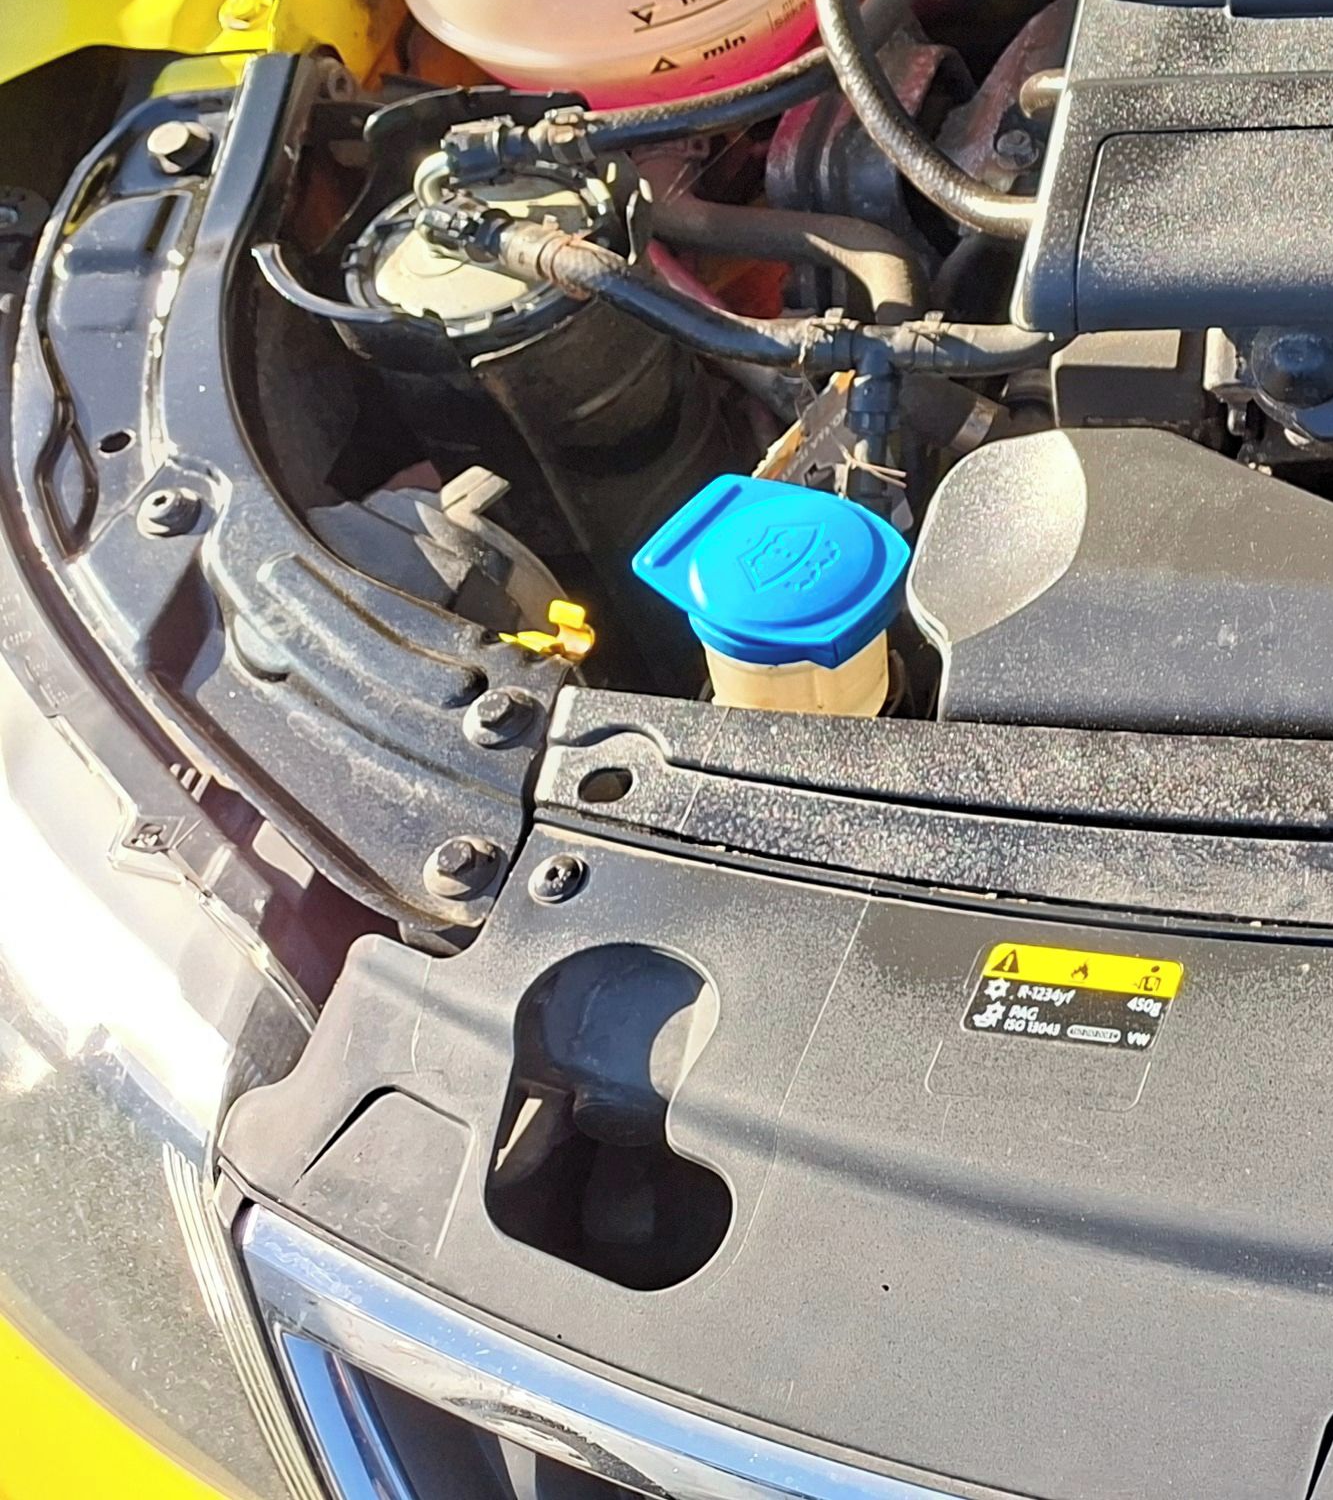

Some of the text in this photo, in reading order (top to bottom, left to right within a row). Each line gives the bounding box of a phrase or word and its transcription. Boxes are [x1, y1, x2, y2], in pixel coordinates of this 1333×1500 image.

[703, 35, 746, 60] min
[1009, 1005, 1039, 1020] PAG
[1127, 997, 1162, 1017] 450g
[1003, 1018, 1026, 1032] ISO
[1127, 1031, 1151, 1046] VW
